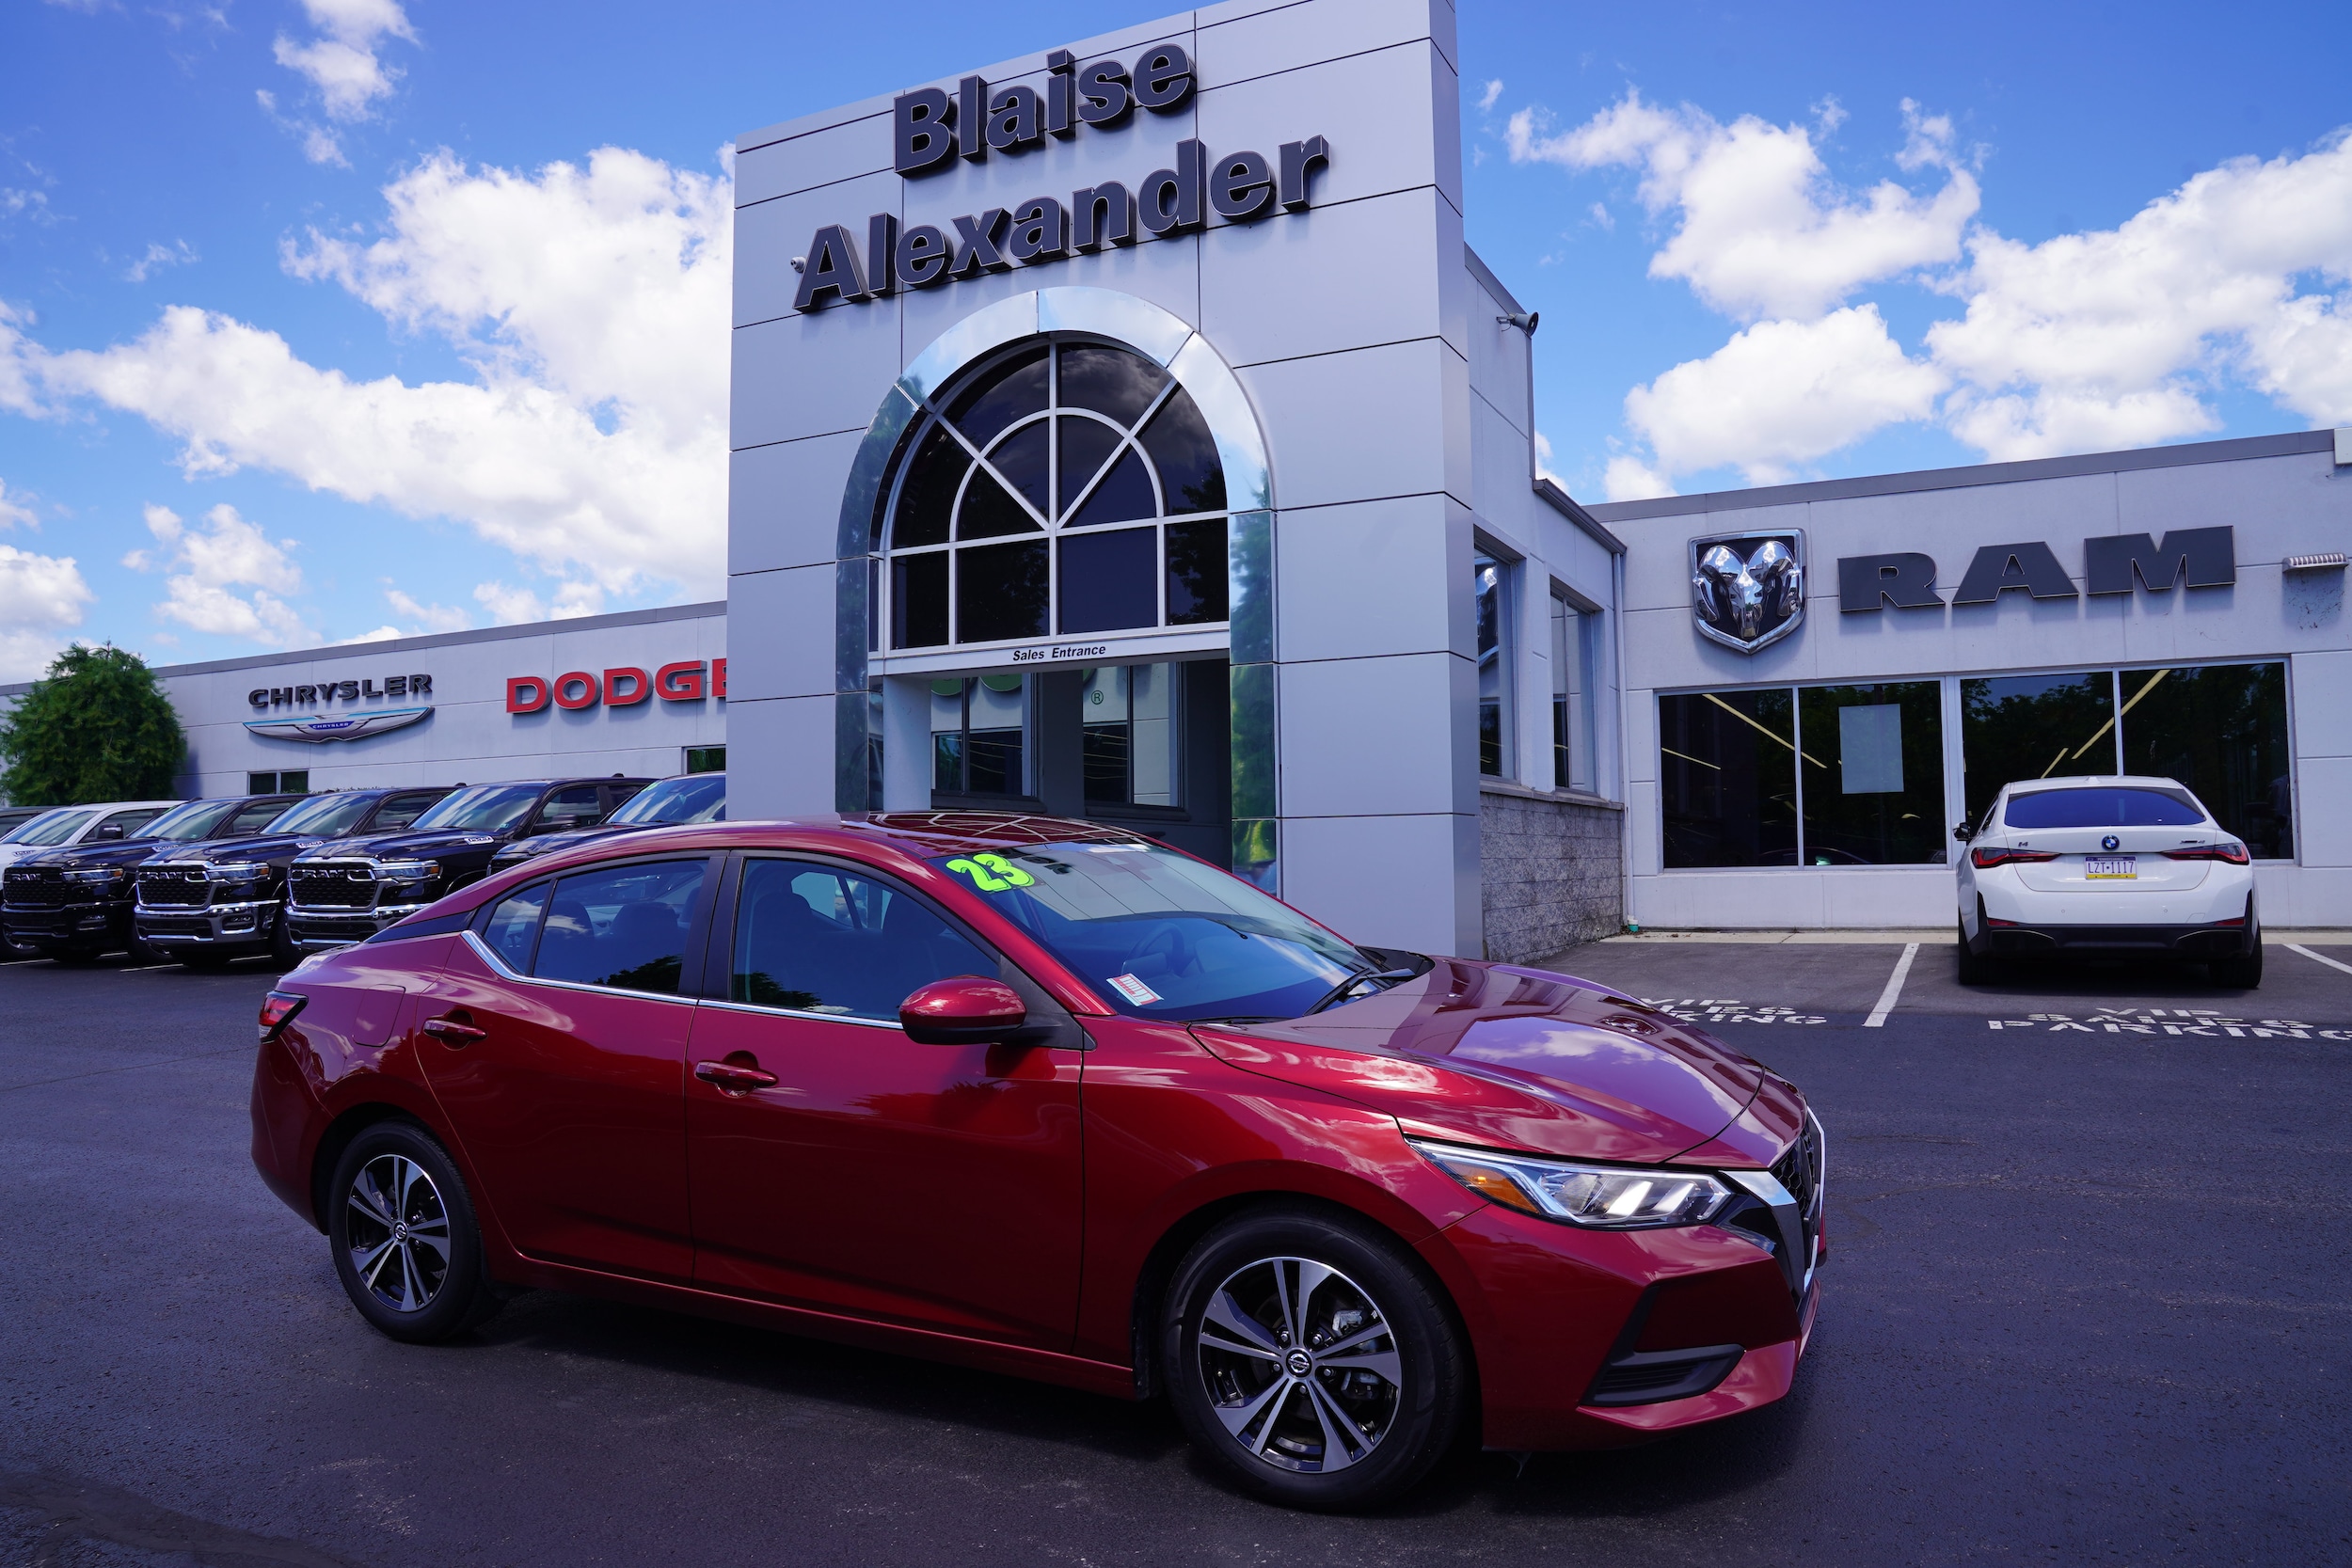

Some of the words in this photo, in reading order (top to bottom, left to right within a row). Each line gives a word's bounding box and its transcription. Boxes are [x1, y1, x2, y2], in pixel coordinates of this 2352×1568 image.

[893, 43, 1197, 177] Blaise
[792, 135, 1329, 312] Alexander
[1836, 525, 2236, 613] RAM
[1012, 649, 1045, 661] Sales
[1051, 645, 1106, 658] Entrance
[247, 673, 433, 708] CHRYSLER
[11, 872, 42, 882] RAM
[946, 853, 1036, 894] 23
[1640, 997, 1741, 1006] VIP
[1660, 1005, 1797, 1016] LES
[1668, 1012, 1828, 1024] KING
[2096, 1007, 2221, 1017] VIP
[2027, 1013, 2314, 1029] SALES
